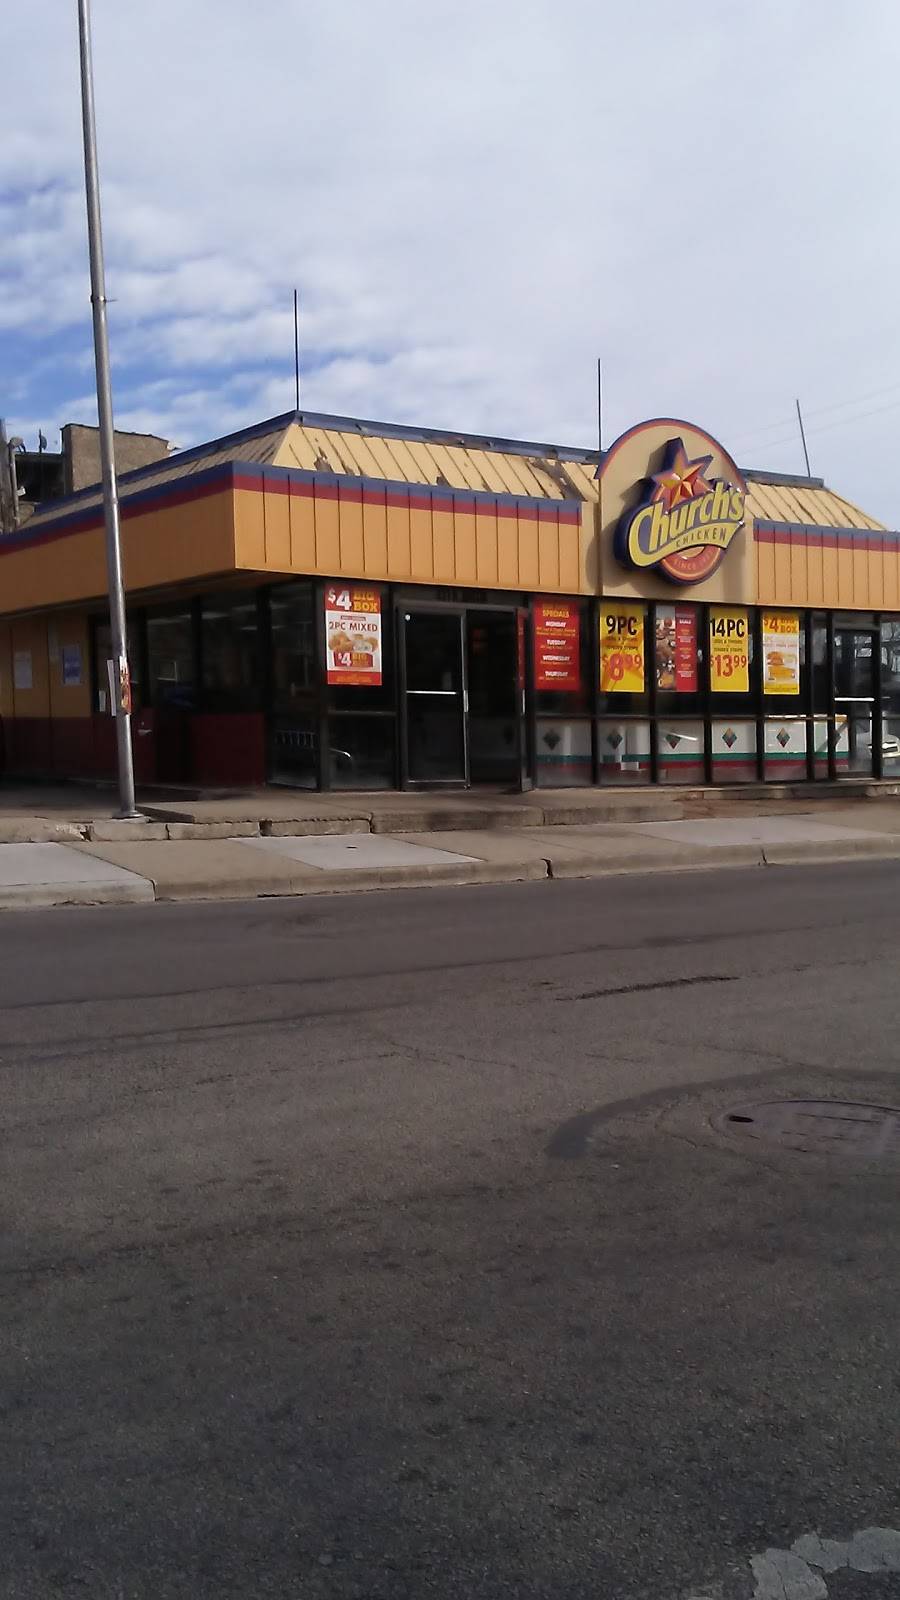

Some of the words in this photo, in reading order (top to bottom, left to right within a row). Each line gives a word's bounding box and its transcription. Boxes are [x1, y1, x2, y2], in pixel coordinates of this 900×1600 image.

[628, 482, 744, 567] Church's
[675, 527, 727, 547] CHICKEN
[328, 588, 352, 611] $4
[353, 601, 378, 612] BOX
[328, 621, 346, 631] 2PC
[349, 623, 378, 632] MIXED
[606, 614, 639, 636] 9PC
[710, 618, 745, 638] 14PC
